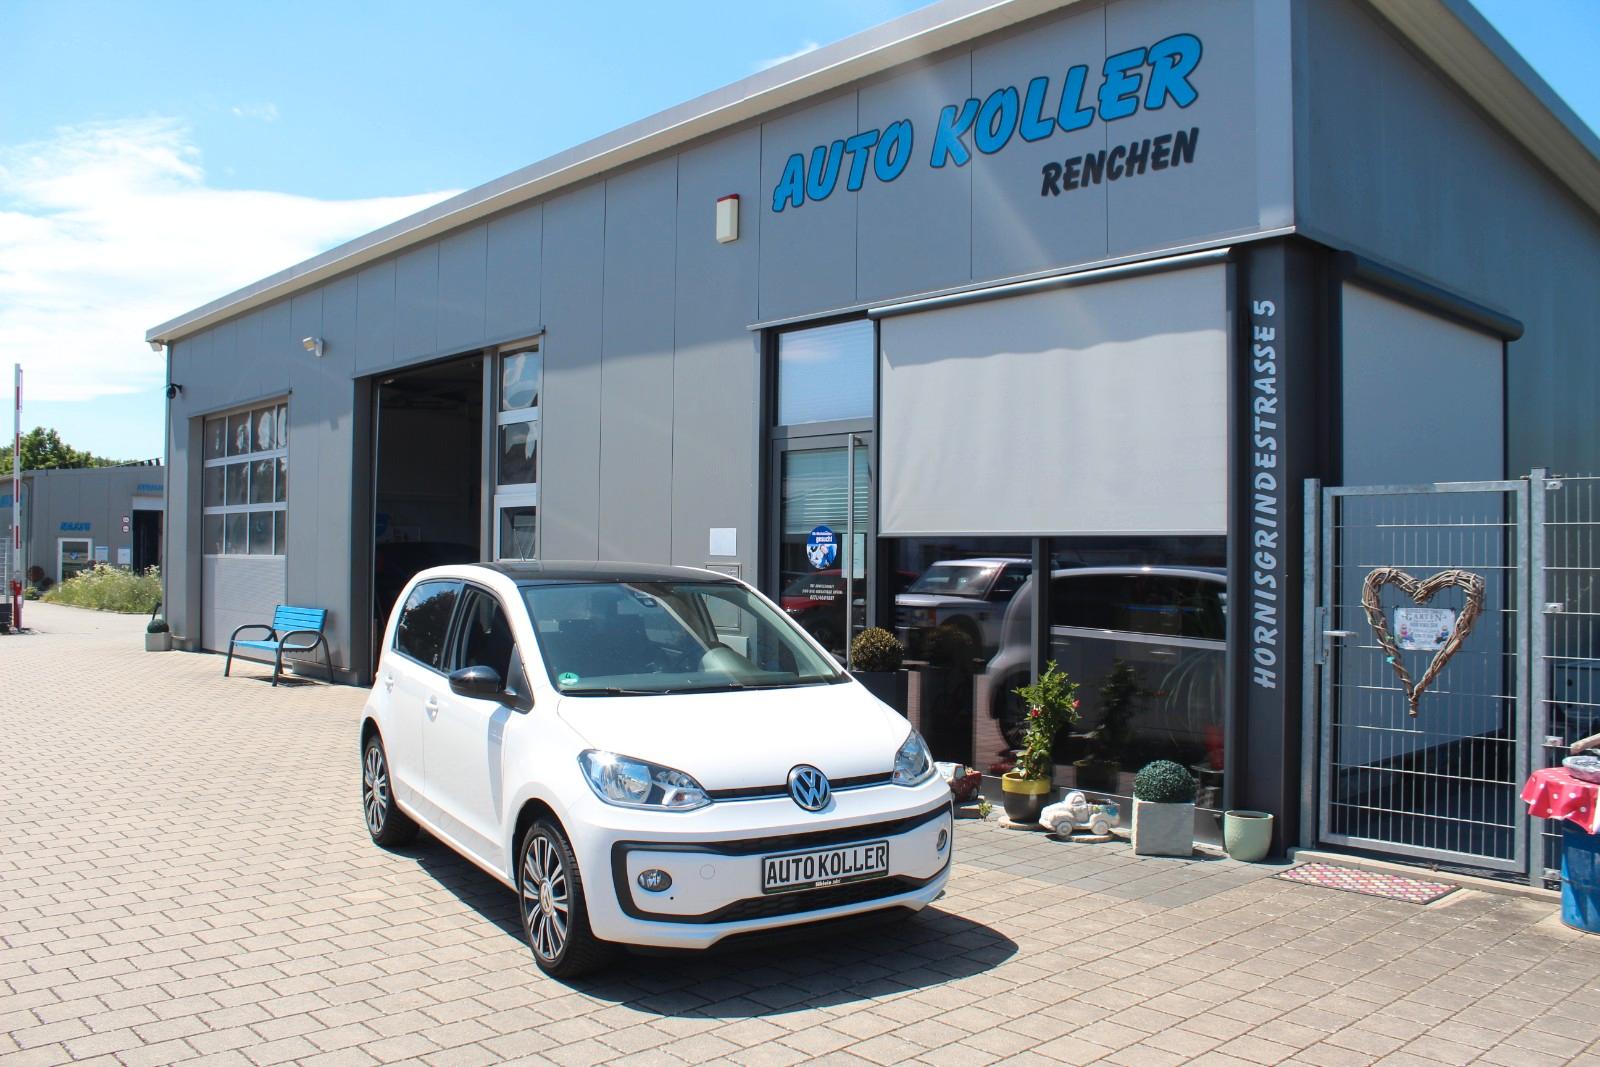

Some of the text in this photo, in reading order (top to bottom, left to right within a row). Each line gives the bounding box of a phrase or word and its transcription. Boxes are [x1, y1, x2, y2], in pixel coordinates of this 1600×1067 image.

[772, 33, 1203, 213] AUTO KOLLER
[1041, 127, 1199, 197] RENCHEN
[1253, 300, 1278, 689] HORNISGRINDESTRASSE 5
[767, 846, 886, 884] AUTO KOLLER
